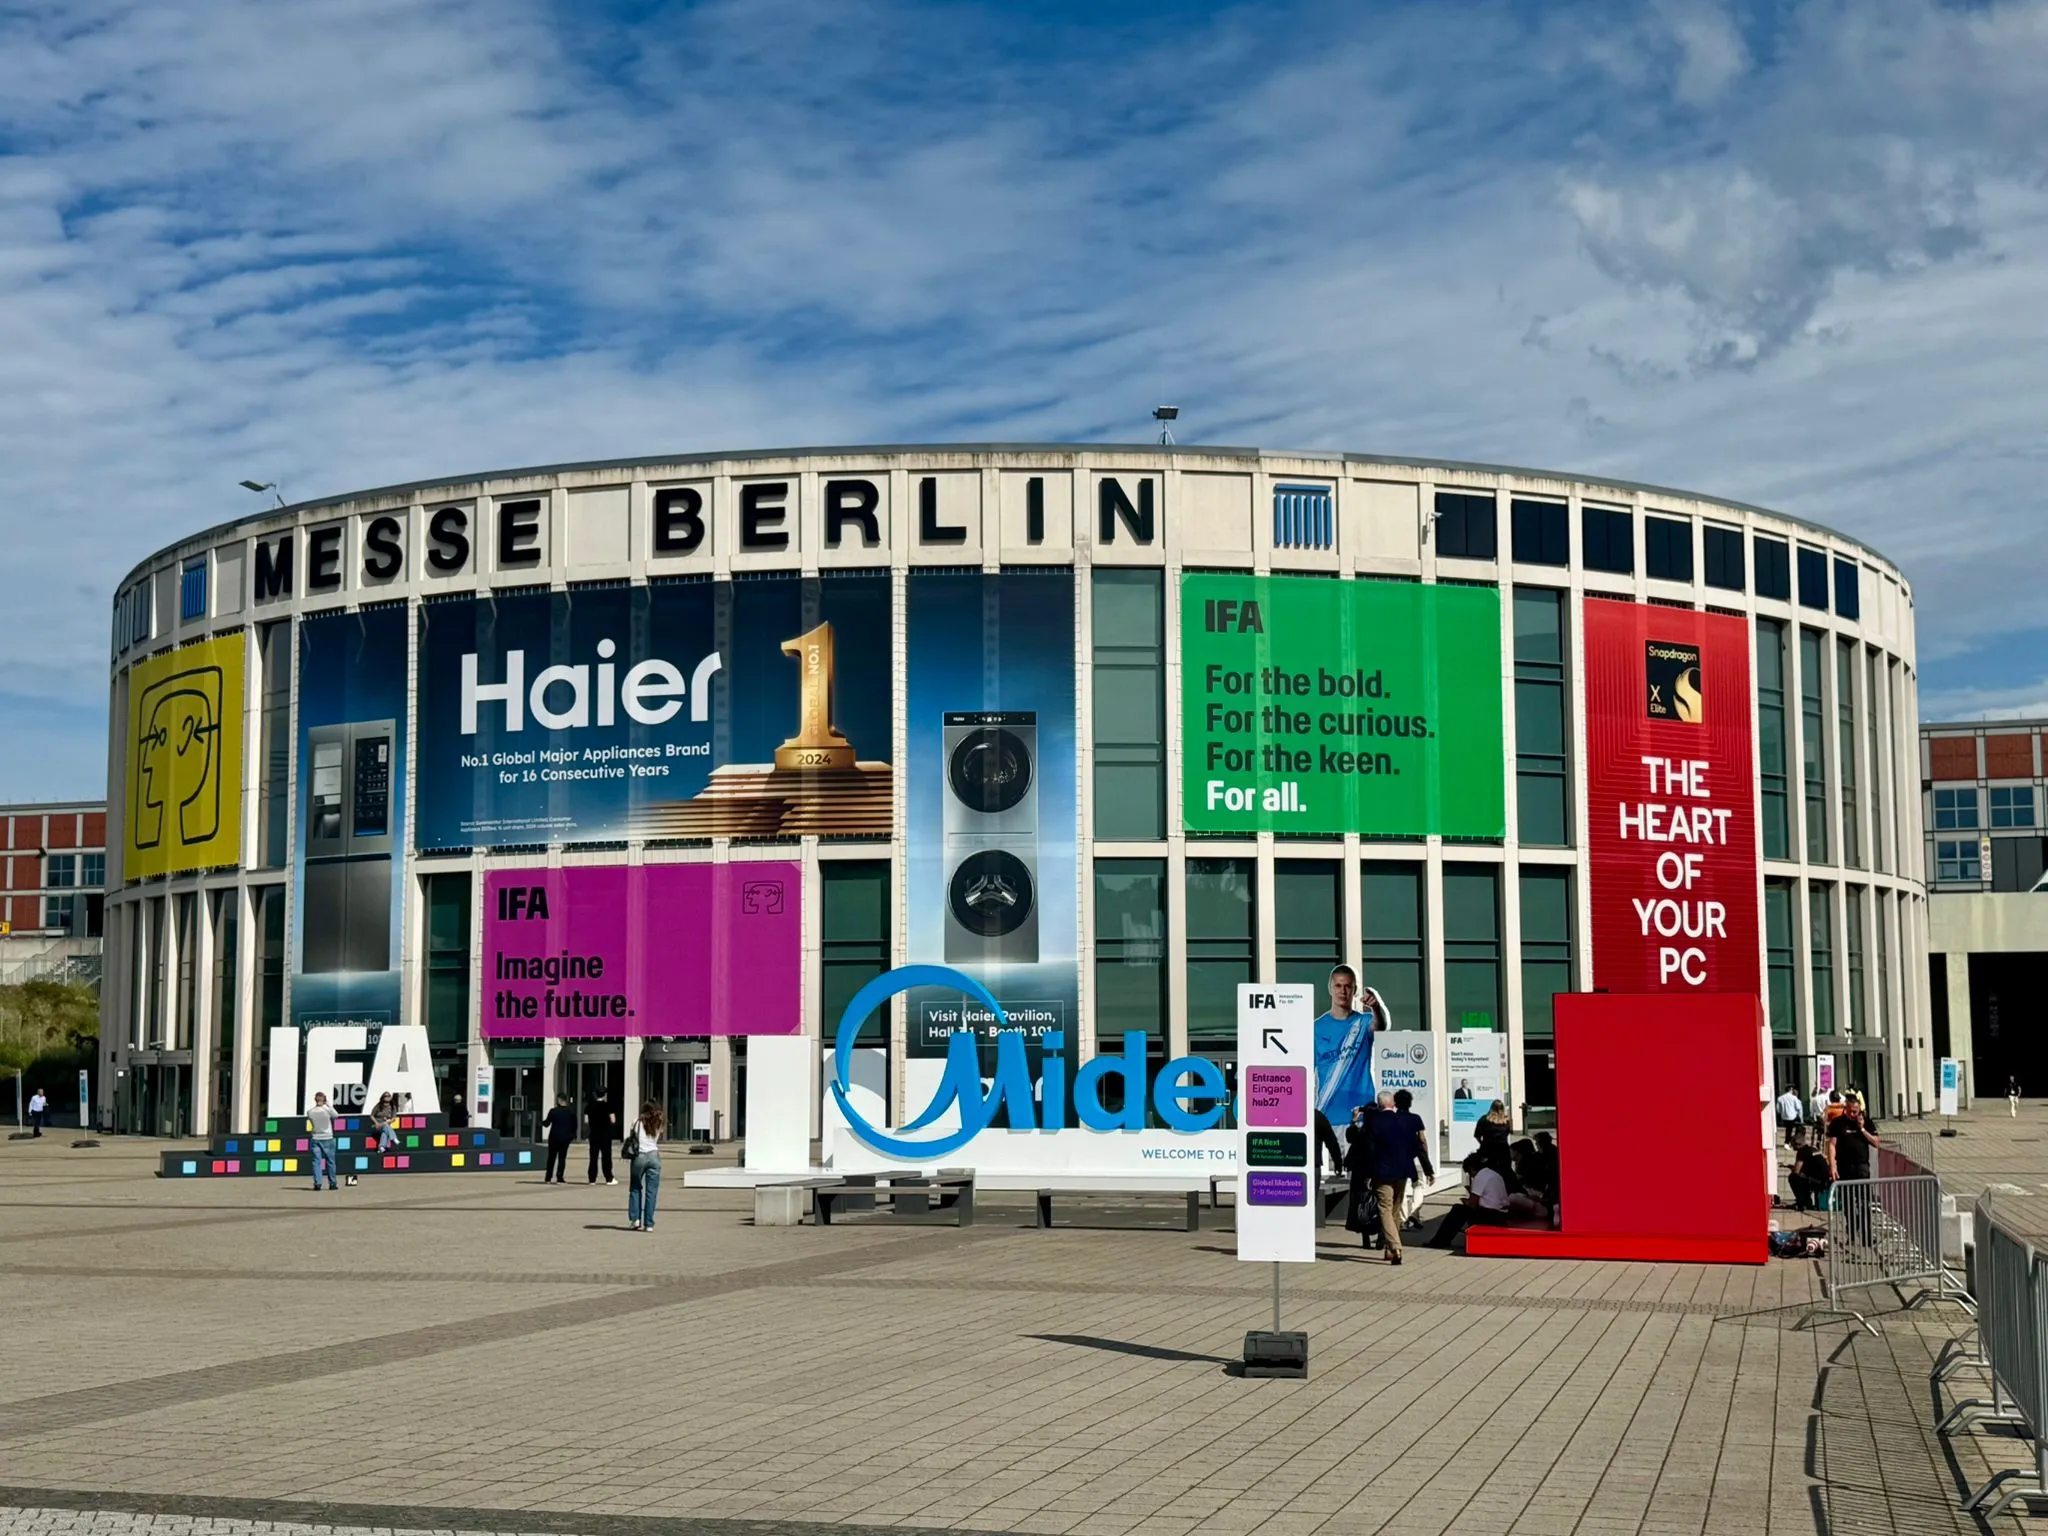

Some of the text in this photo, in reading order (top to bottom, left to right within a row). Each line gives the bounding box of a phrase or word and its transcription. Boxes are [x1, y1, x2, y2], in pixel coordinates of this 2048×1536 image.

[255, 477, 1154, 600] MESSE BERLIN
[1205, 599, 1264, 634] IFA
[808, 645, 820, 675] NO.1
[1648, 645, 1698, 663] Snapdragon
[461, 638, 722, 735] Haier
[1206, 664, 1391, 699] For the bold.
[1650, 684, 1661, 703] X
[1206, 703, 1435, 738] For the curious.
[1650, 703, 1667, 714] Elite
[461, 742, 711, 768] No.1 Global Major Appliances Brand
[797, 754, 832, 766] 2024
[1207, 742, 1400, 775] For the keen.
[499, 763, 670, 784] for 16 Consecutive Years
[1641, 755, 1711, 797] THE
[1207, 780, 1307, 812] For all.
[1619, 801, 1733, 846] HEART
[1656, 851, 1705, 890] OF
[498, 886, 550, 921] IFA
[1631, 898, 1728, 939] YOUR
[496, 949, 604, 986] Imagine
[1659, 947, 1708, 986] PC
[495, 989, 635, 1018] the future.
[929, 1010, 958, 1021] Visit
[1249, 993, 1276, 1009] IFA
[929, 1026, 955, 1037] Hall
[1450, 1036, 1463, 1044] IFA
[268, 1025, 441, 1117] IFA
[831, 965, 1237, 1159] Mide
[1382, 1070, 1415, 1078] ERLING
[1252, 1073, 1292, 1083] Entrance
[1252, 1084, 1293, 1096] Eingang
[1382, 1079, 1427, 1088] HAALAND
[1252, 1097, 1280, 1107] hub27
[1141, 1148, 1205, 1160] WELCOME
[1208, 1150, 1225, 1160] TO
[1252, 1179, 1274, 1187] Global
